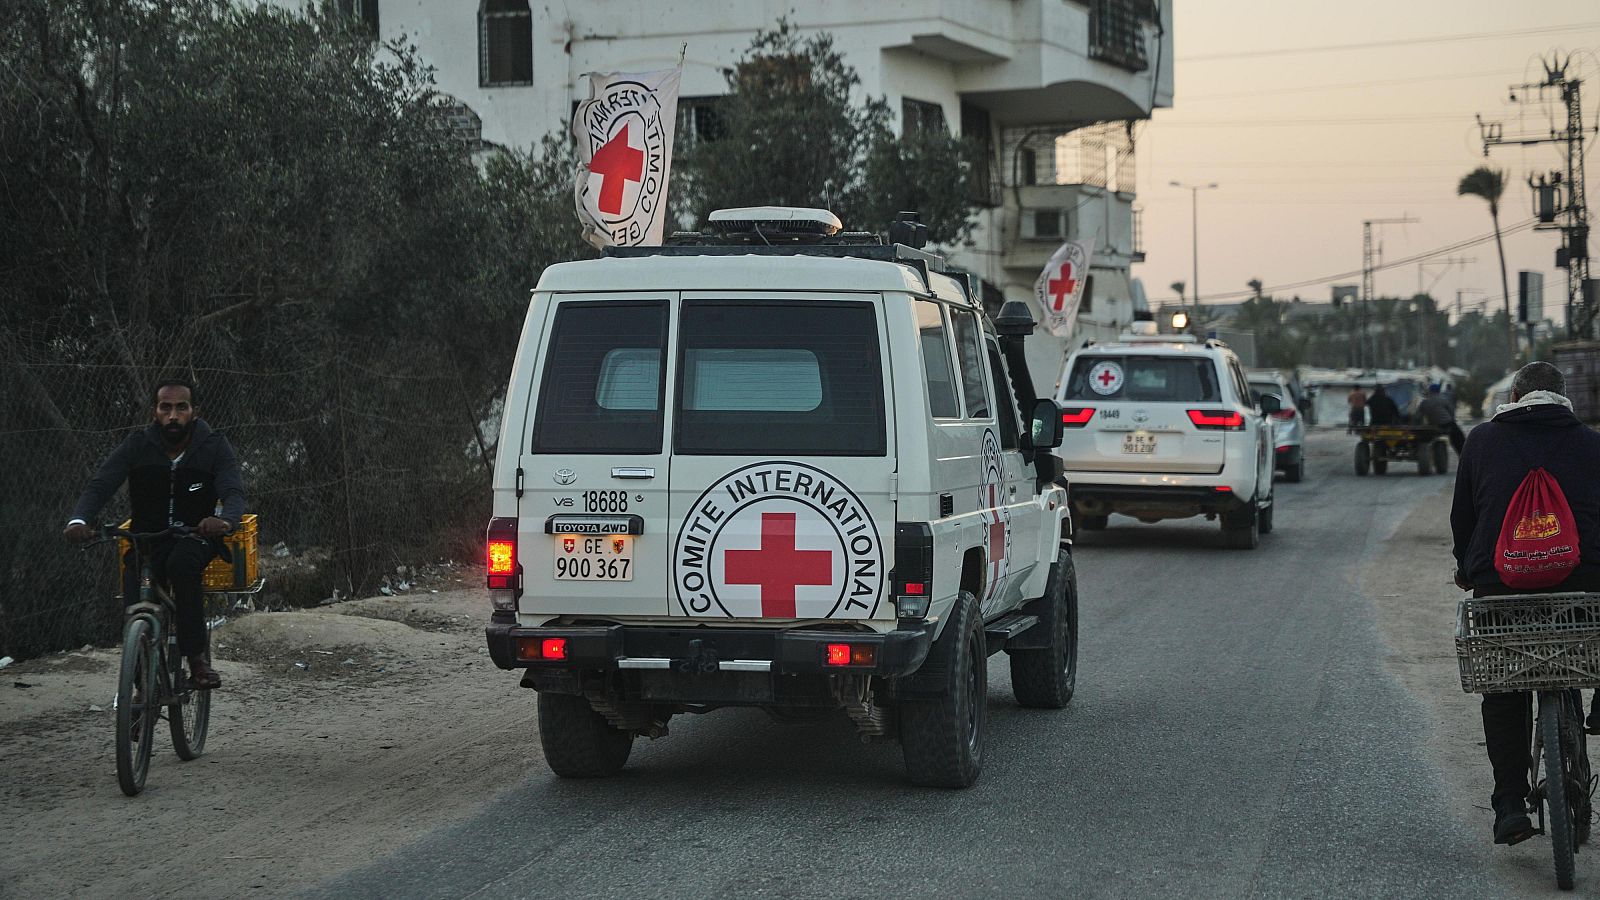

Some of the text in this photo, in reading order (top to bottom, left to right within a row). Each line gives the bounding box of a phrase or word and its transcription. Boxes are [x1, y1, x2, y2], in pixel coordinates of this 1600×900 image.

[553, 490, 628, 513] V8 18688
[557, 524, 628, 532] TOYOTA 4WD
[584, 539, 603, 554] GE
[682, 499, 725, 614] COMITE
[725, 469, 876, 612] INTERNATIONAL
[556, 557, 630, 578] 900 367
